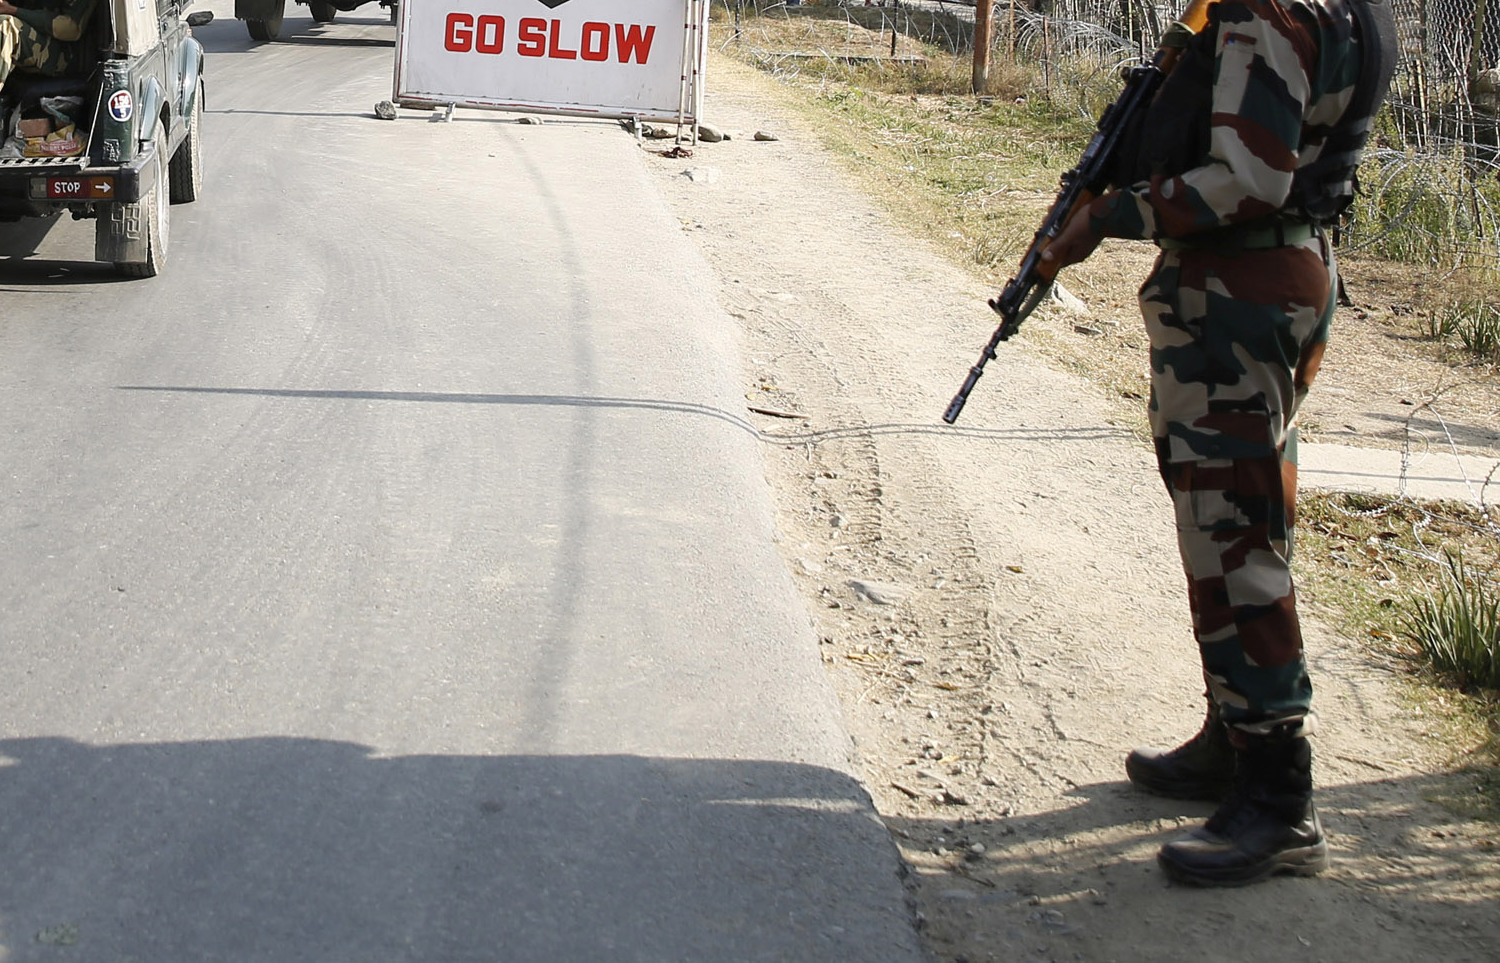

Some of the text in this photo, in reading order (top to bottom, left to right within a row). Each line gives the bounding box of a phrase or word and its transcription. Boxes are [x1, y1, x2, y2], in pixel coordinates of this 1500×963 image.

[444, 12, 656, 65] GO SLOW
[54, 181, 81, 194] STOP
